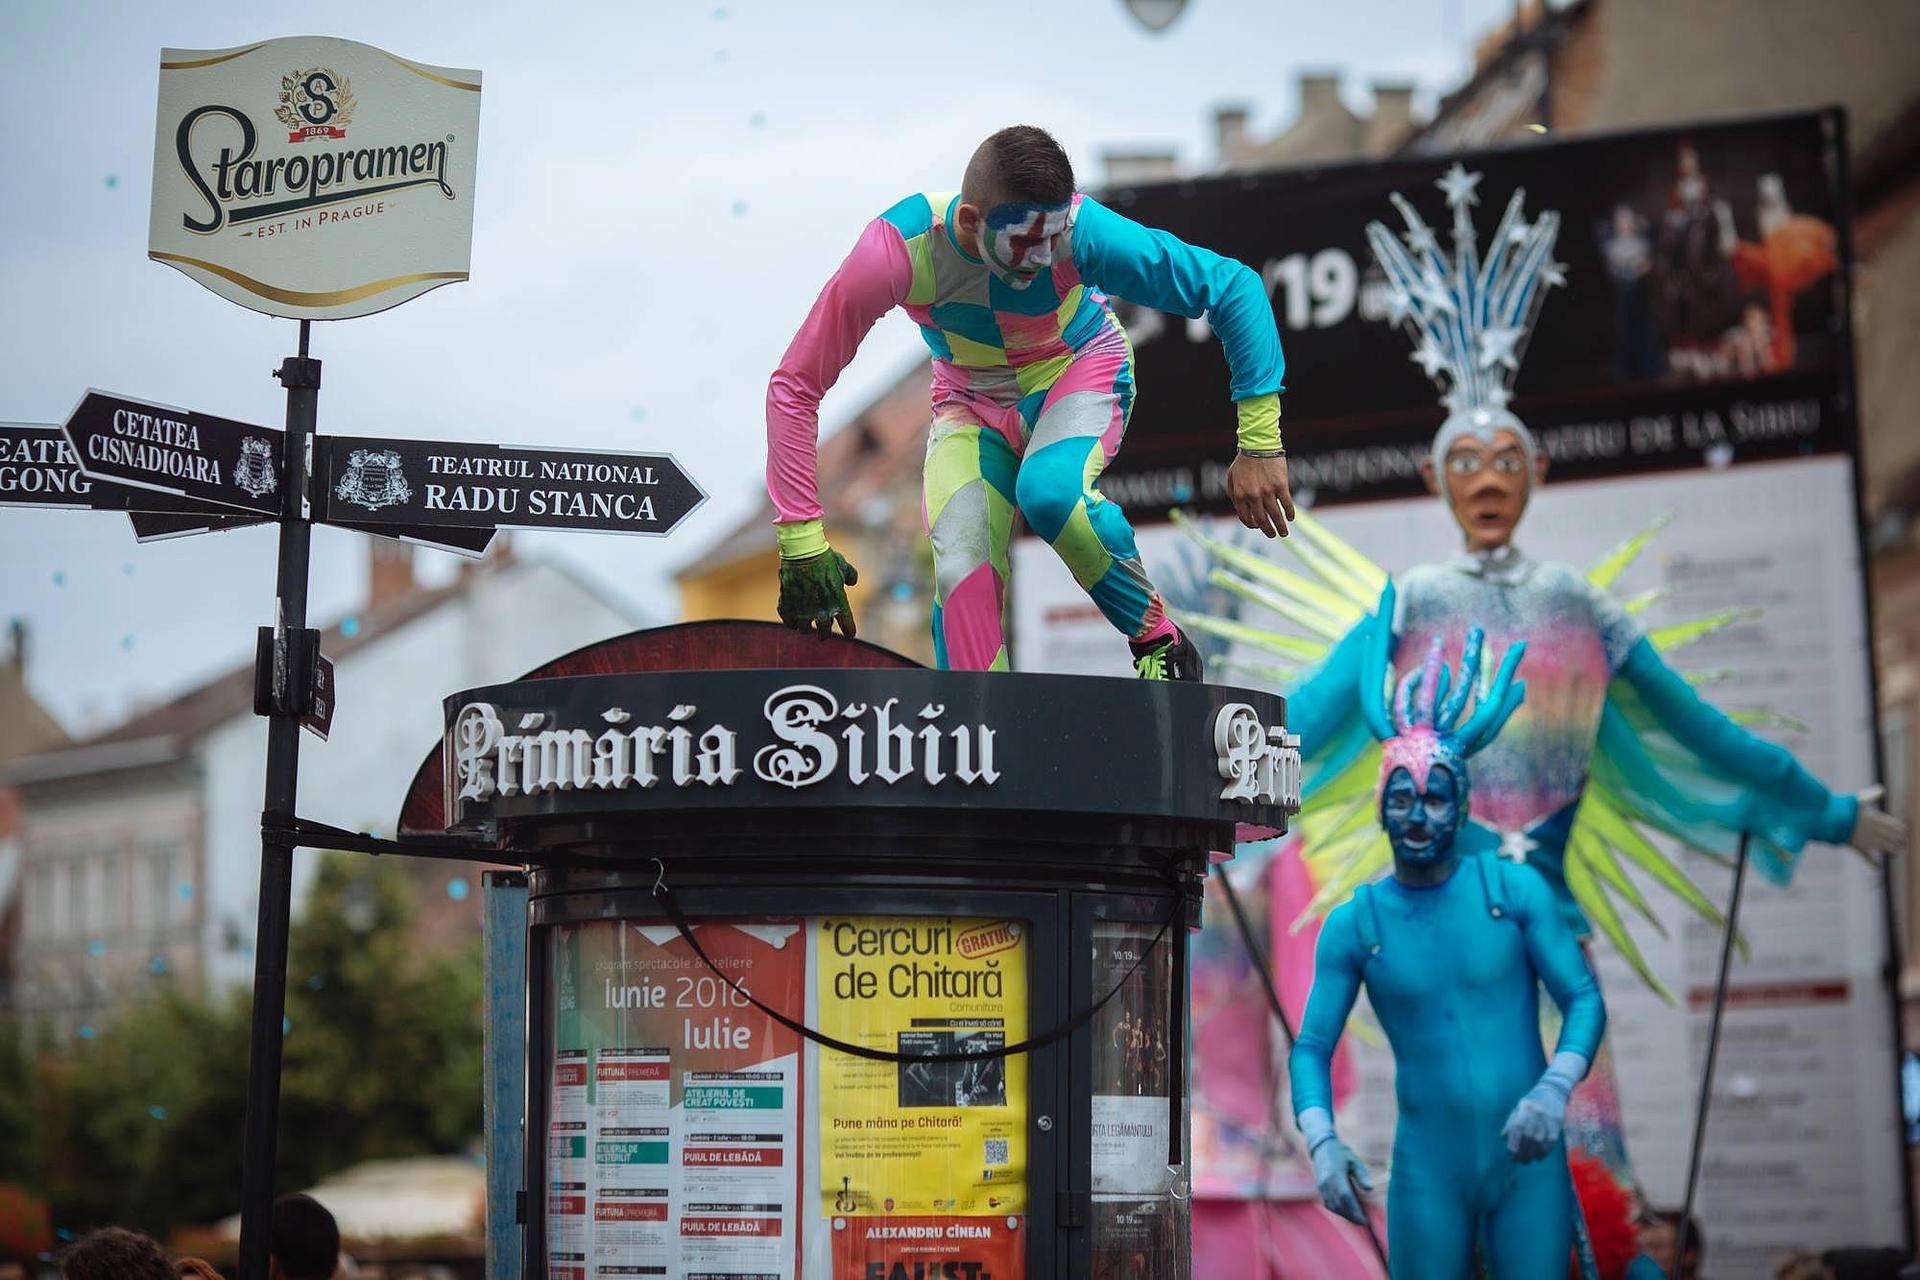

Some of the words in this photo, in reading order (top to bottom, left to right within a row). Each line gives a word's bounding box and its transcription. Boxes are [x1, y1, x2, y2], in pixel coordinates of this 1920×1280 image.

[305, 126, 330, 136] 1869
[176, 104, 455, 233] Staropramen
[257, 223, 288, 238] EST.
[295, 217, 311, 231] IN
[318, 202, 385, 225] PRAGUE
[113, 408, 200, 450] CETATEA
[88, 433, 222, 485] CISNADIOARA
[427, 455, 534, 479] TEATRUL
[540, 461, 659, 485] NATIONAL
[0, 466, 93, 494] GONG
[424, 484, 520, 513] RADU
[528, 489, 658, 521] STANCA
[754, 684, 1001, 789] Sibiu
[834, 920, 952, 957] Cercuri
[634, 955, 690, 970] spectacole
[605, 976, 666, 1008] Iunie
[676, 976, 751, 1008] 2016
[834, 963, 878, 999] de
[889, 960, 1002, 998] Chitară
[685, 1018, 751, 1050] Iulie
[732, 1088, 746, 1098] DE
[833, 1119, 862, 1130] Pune
[866, 1117, 898, 1129] mâna
[901, 1119, 915, 1130] pe
[918, 1116, 963, 1129] Chitară!
[684, 1152, 708, 1162] PUIUL
[709, 1152, 721, 1162] DE
[682, 1222, 706, 1232] PUIUL
[707, 1222, 720, 1232] DE
[866, 1226, 943, 1239] ALEXANDRU
